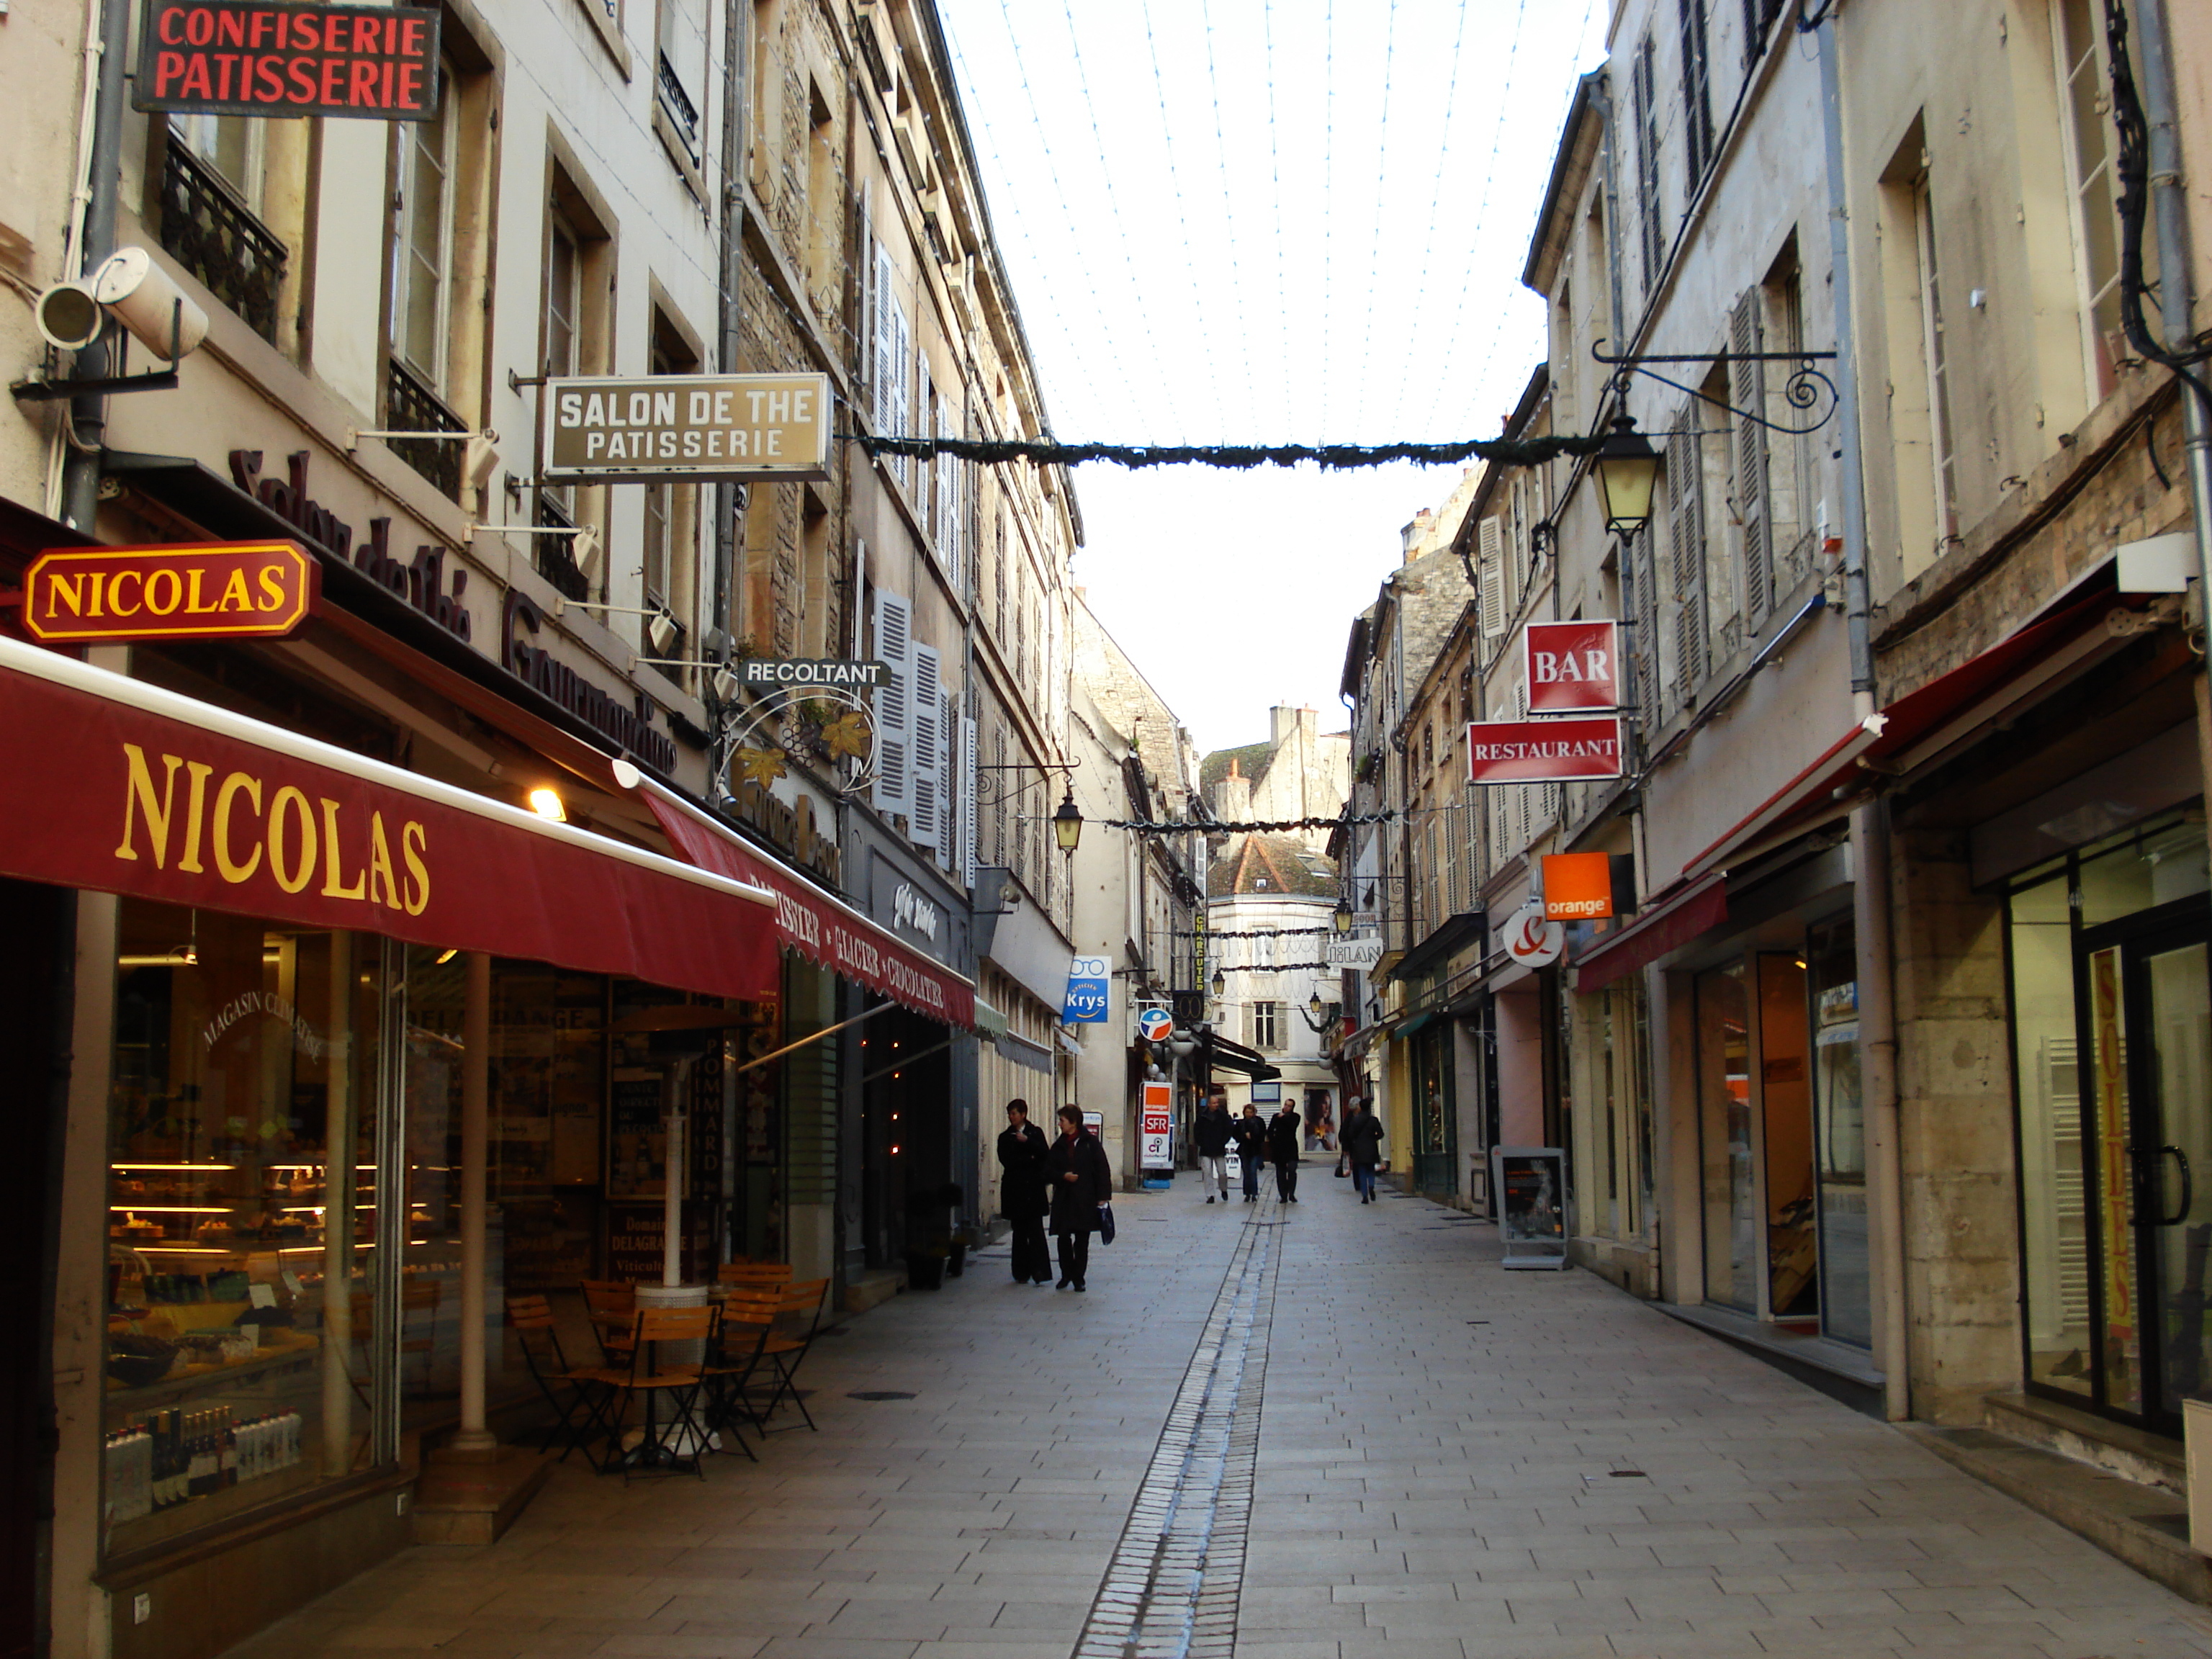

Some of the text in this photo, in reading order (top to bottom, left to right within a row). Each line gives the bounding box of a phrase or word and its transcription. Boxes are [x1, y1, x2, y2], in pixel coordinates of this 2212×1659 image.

[158, 6, 426, 57] CONFISERIE
[155, 51, 423, 110] PATISSERIE
[559, 389, 814, 427] SALON DE THE
[586, 428, 783, 459] PATISSERIE
[46, 565, 286, 619] NICOLAS
[747, 662, 881, 684] RECOLTANT
[1534, 649, 1610, 683] BAR
[1475, 739, 1616, 760] RESTAURANT
[115, 742, 431, 916] NICOLAS
[1548, 899, 1605, 915] orange
[835, 925, 880, 979] GLACIER
[888, 956, 943, 1009] CHOCOLATIER
[1067, 993, 1105, 1010] Krys
[203, 991, 261, 1052] MAGASIN
[703, 1039, 721, 1171] POMMARD
[1146, 1118, 1166, 1130] SFR
[2097, 963, 2129, 1318] SOLDES
[612, 1236, 687, 1251] DELAGRAE
